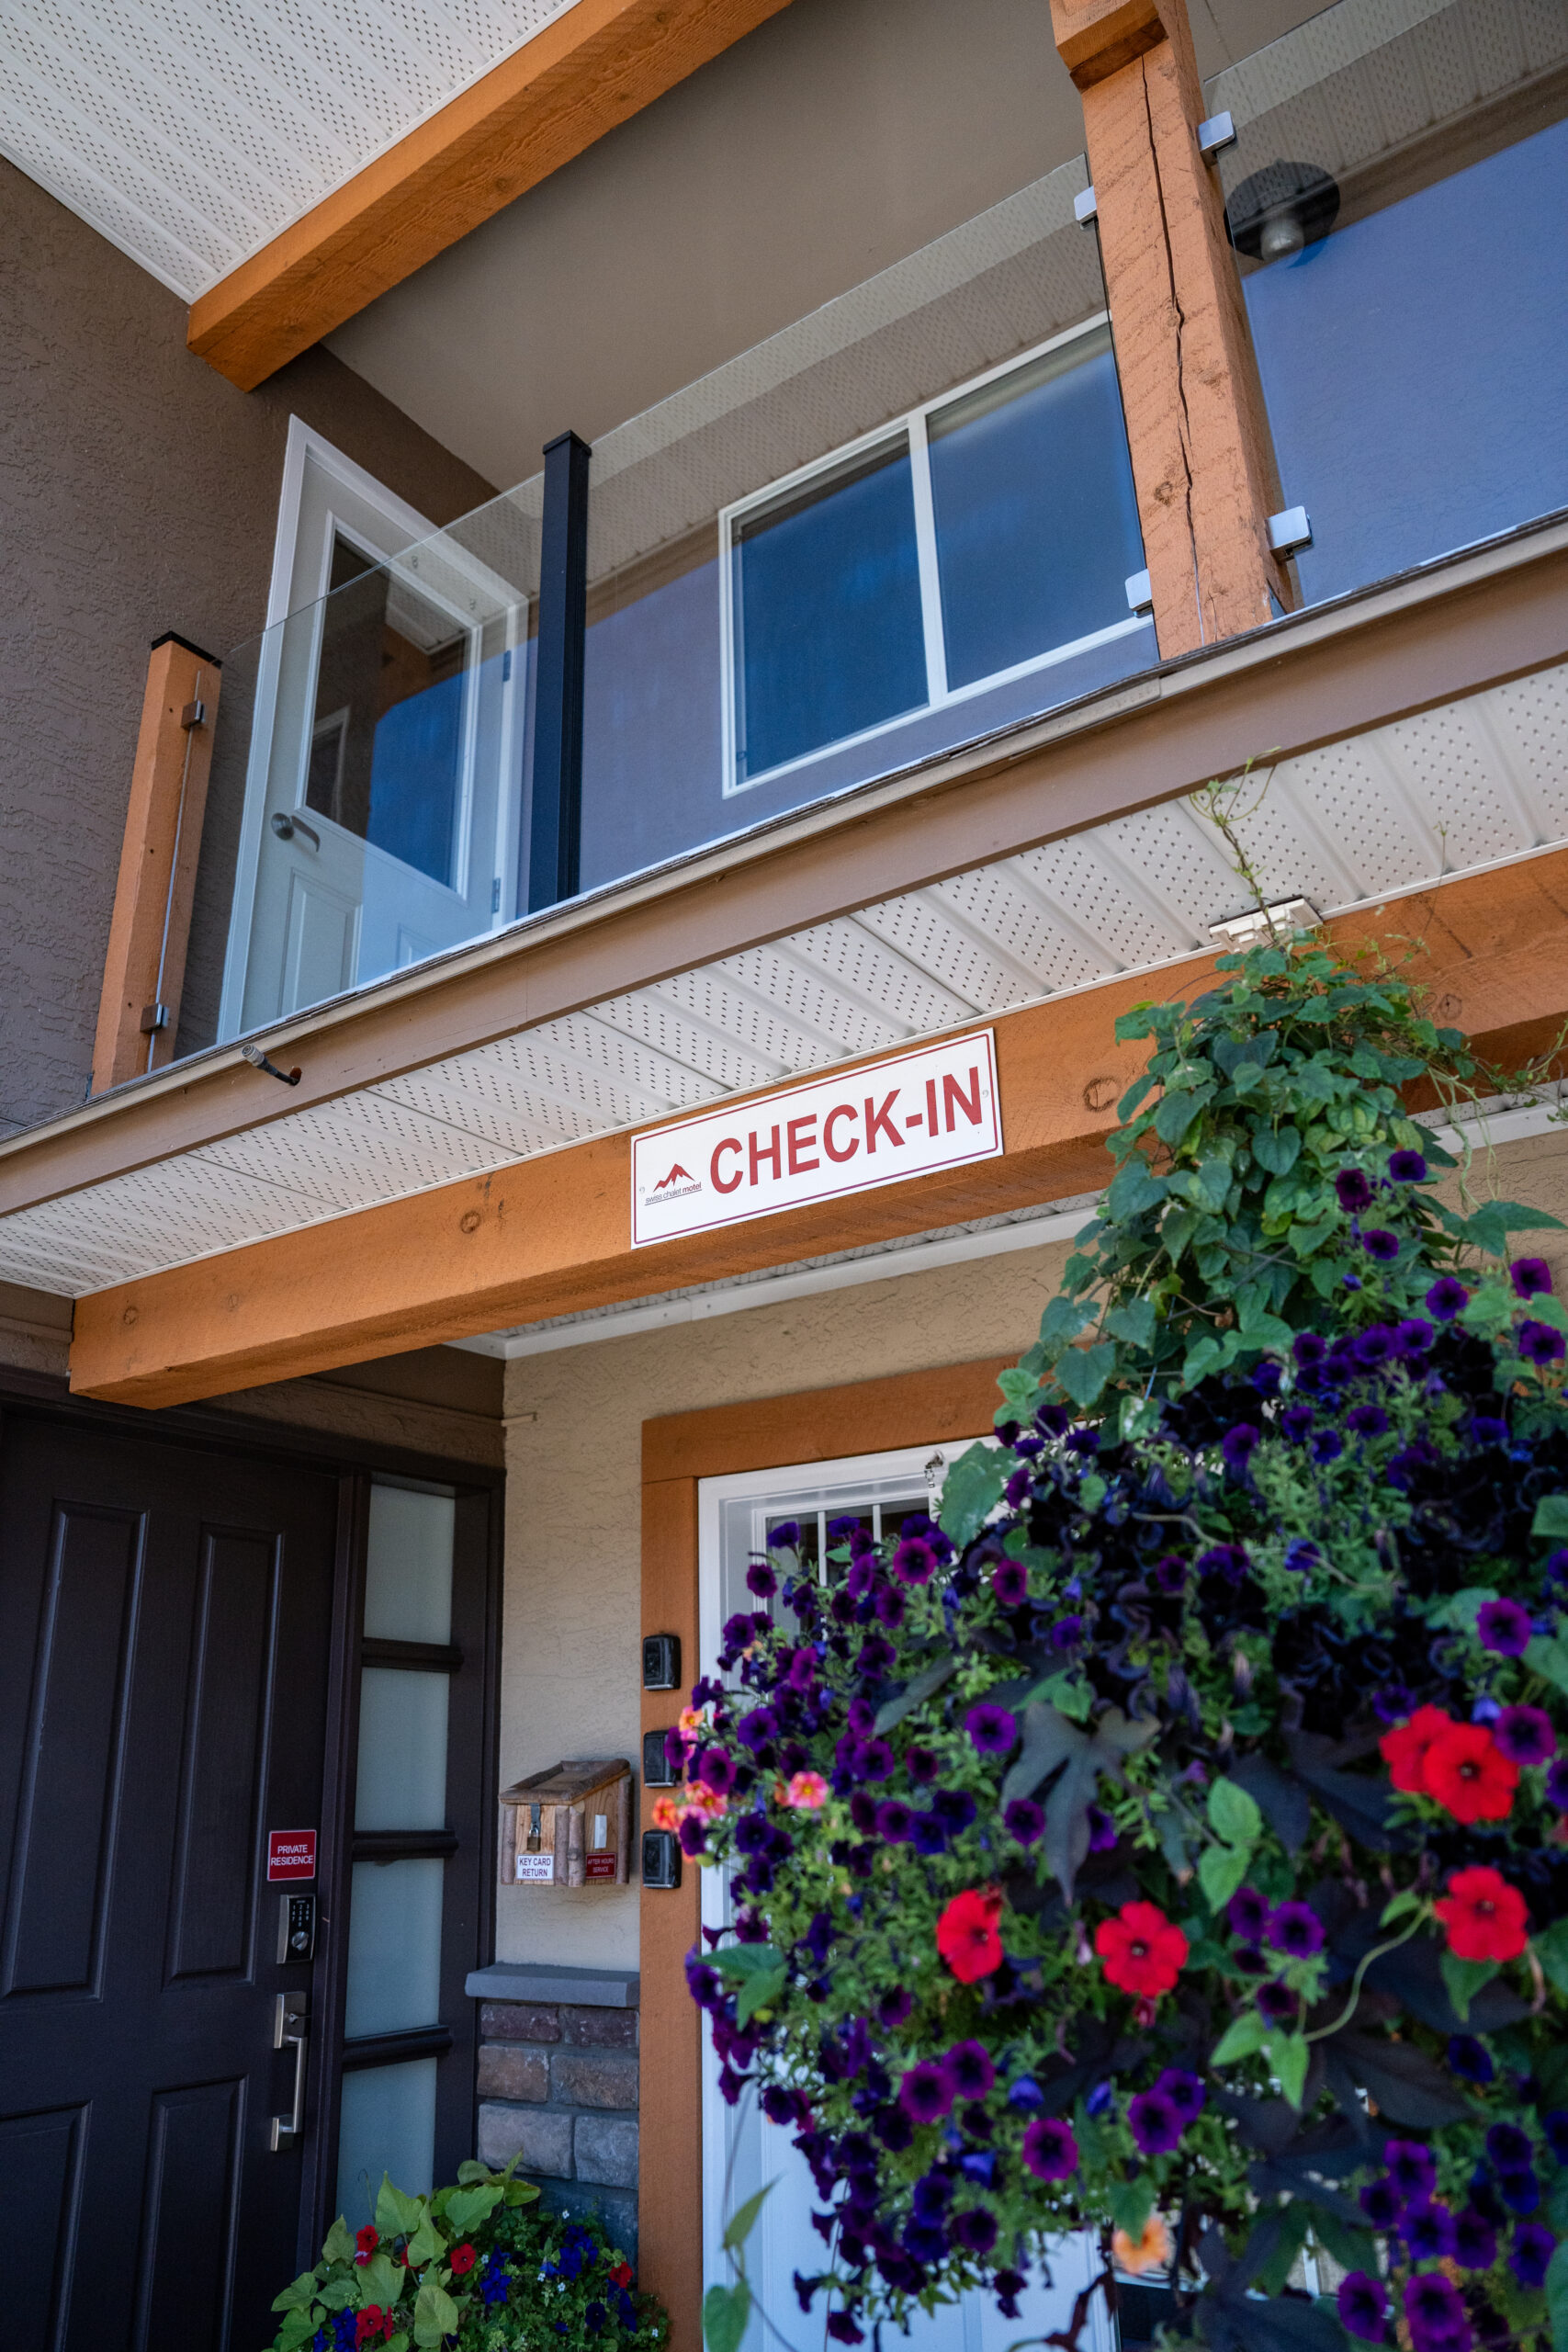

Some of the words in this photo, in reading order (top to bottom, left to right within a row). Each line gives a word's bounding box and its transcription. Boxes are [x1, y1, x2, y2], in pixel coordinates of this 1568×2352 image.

[710, 1066, 983, 1194] CHECK-IN
[645, 1194, 662, 1204] swiss
[662, 1188, 682, 1198] chalet
[682, 1182, 702, 1193] motel
[277, 1844, 308, 1854] PRIVATE
[270, 1855, 314, 1866] RESIDENCE
[519, 1857, 532, 1866] KEY
[533, 1857, 551, 1866] CARD
[522, 1868, 548, 1877] RETURN
